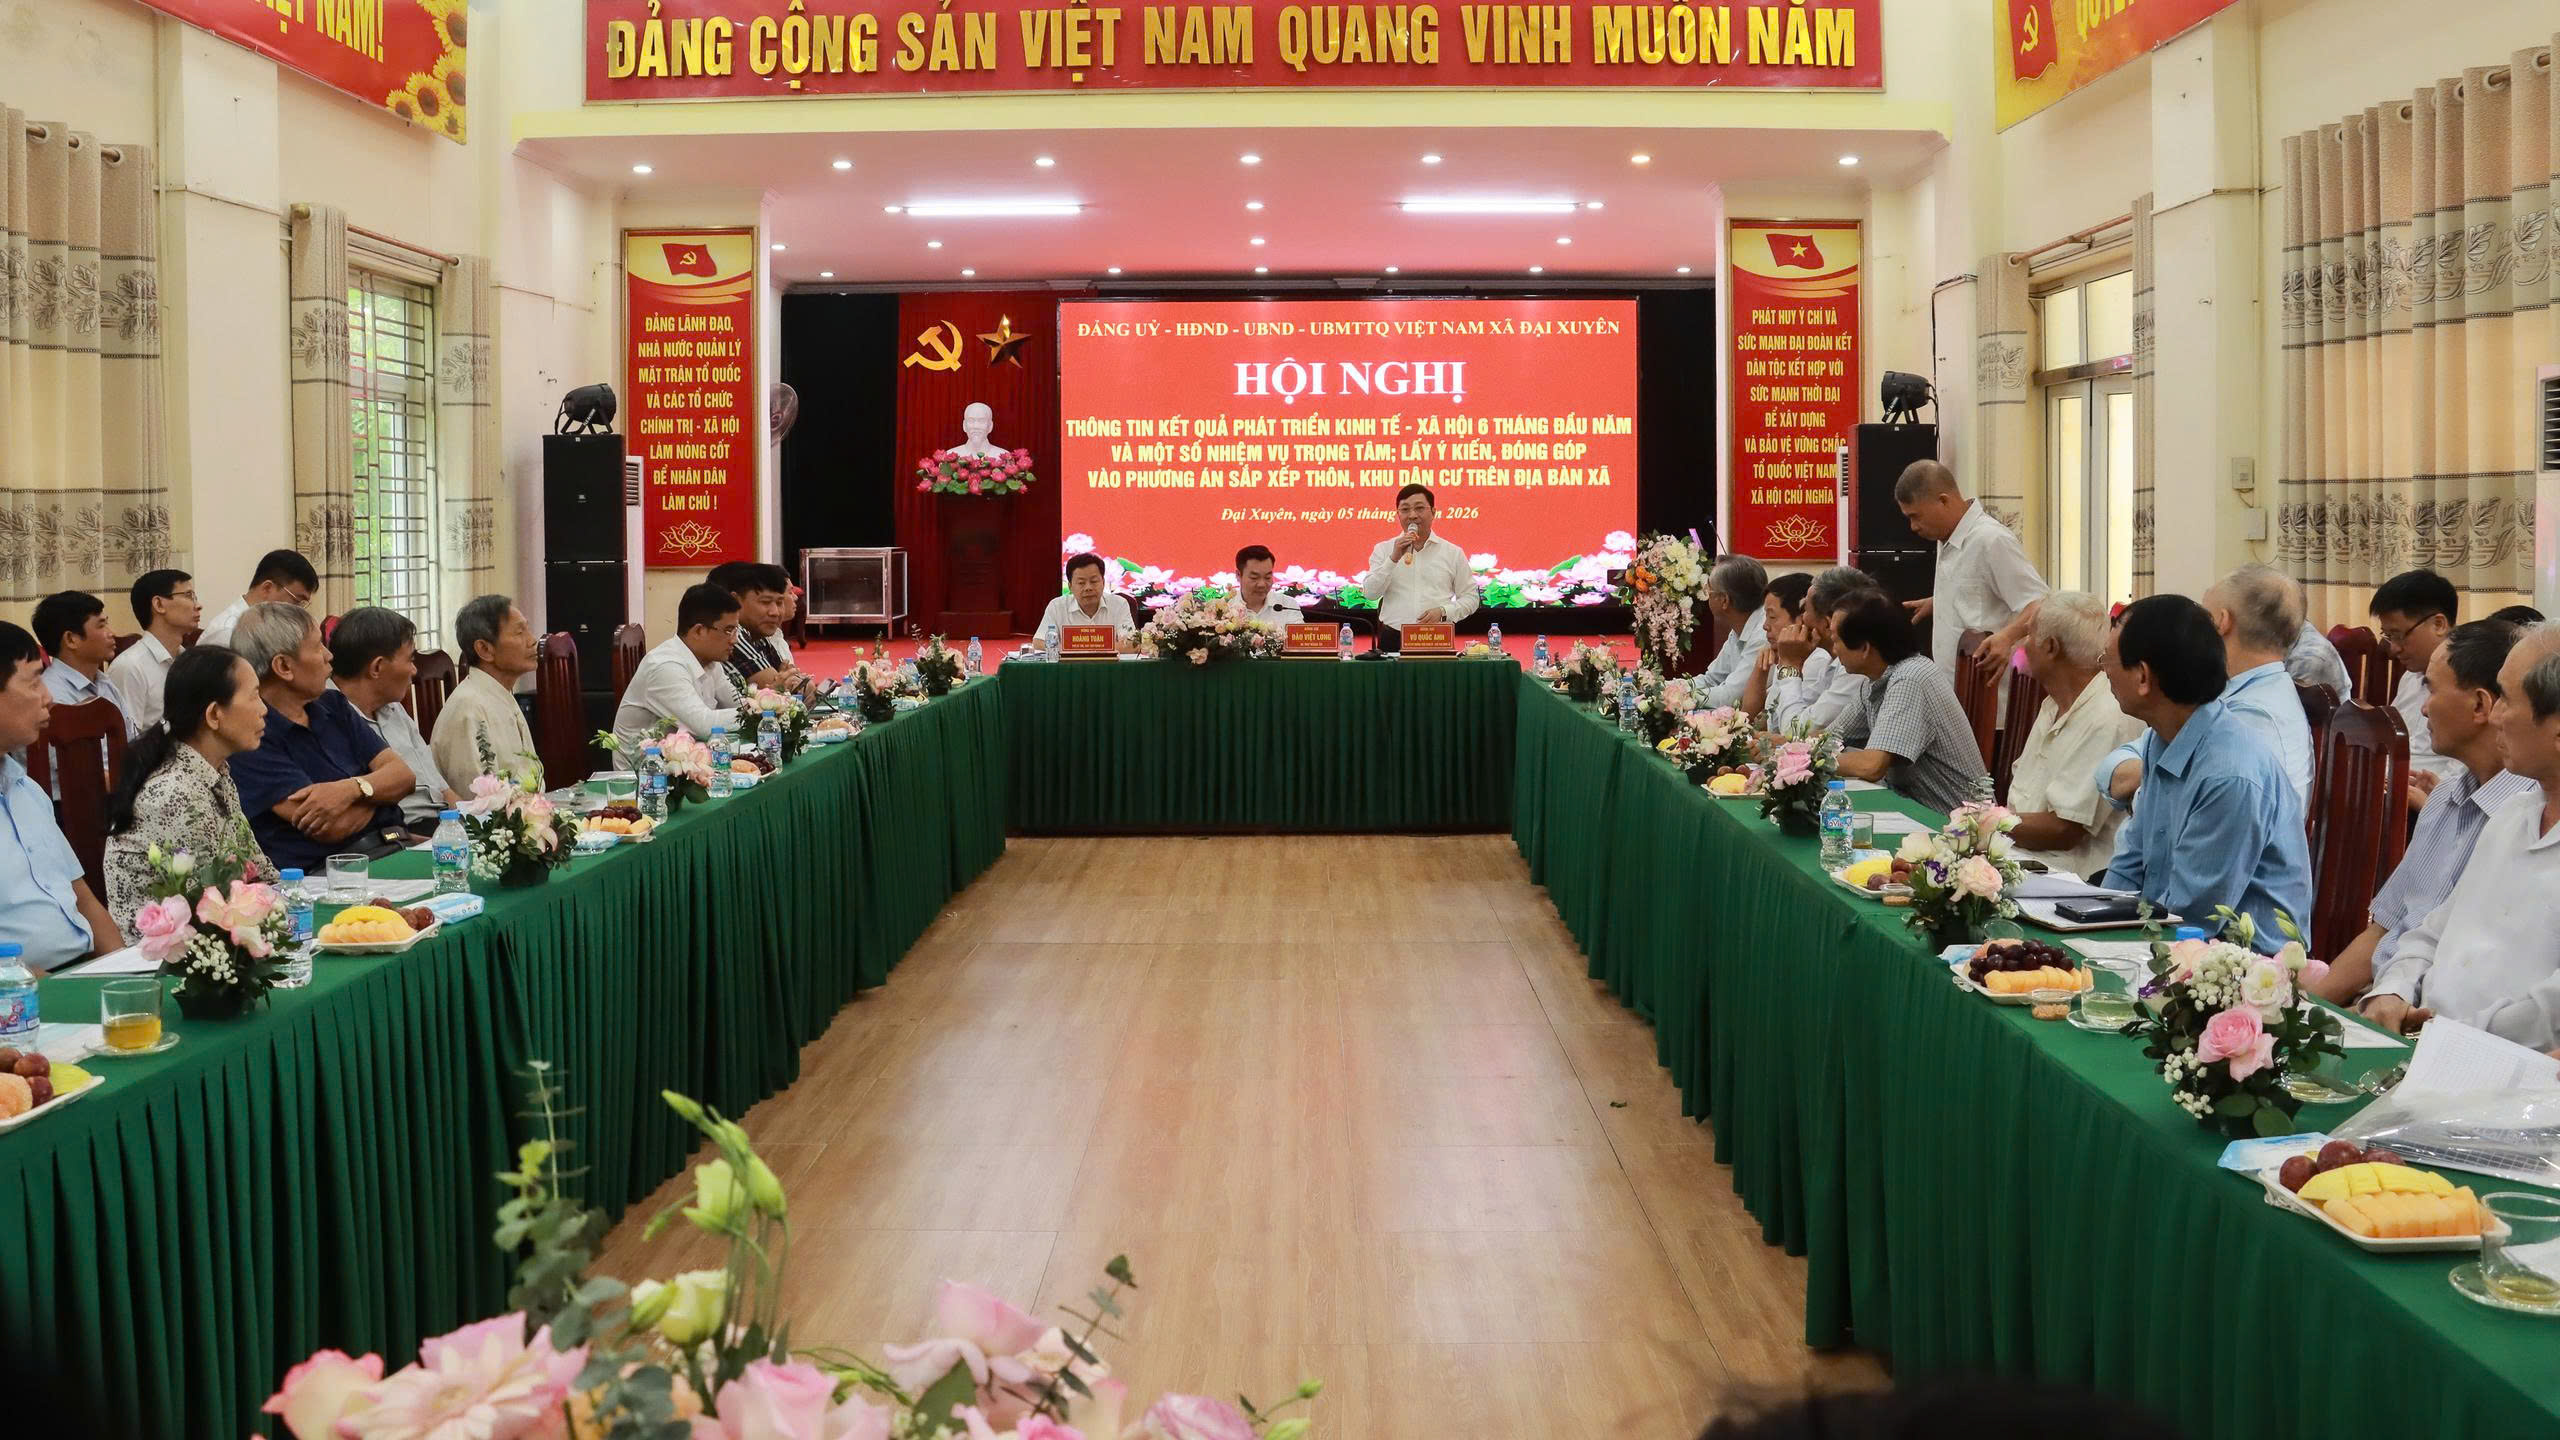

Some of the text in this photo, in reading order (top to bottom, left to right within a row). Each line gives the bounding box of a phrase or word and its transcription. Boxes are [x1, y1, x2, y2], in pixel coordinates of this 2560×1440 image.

[606, 0, 734, 78] ĐẢNG
[750, 0, 878, 89] CỘNG
[897, 0, 997, 72] SẢN
[1019, 0, 1121, 82] VIỆT
[1143, 5, 1254, 65] NAM
[1278, 5, 1439, 72] QUANG
[1461, 5, 1572, 64] VINH
[645, 312, 734, 334] ĐẢNG LÃNH ĐẠO,
[1078, 320, 1130, 336] ĐẢNG
[1176, 323, 1228, 336] HĐND
[1244, 322, 1294, 336] UBND
[1310, 321, 1390, 338] UBMTTQ
[1394, 320, 1437, 338] VIỆT
[1442, 321, 1484, 334] NAM
[1490, 318, 1514, 334] XÃ
[1520, 321, 1551, 337] ĐẠI
[1557, 317, 1619, 334] XUYÊN
[1752, 307, 1838, 325] PHÁT HUY Ý CHÍ VÀ
[638, 337, 741, 358] NHÀ NƯỚC QUẢN LÝ
[1738, 330, 1852, 354] SỨC MẠNH ĐẠI ĐOÀN KẾT
[638, 361, 741, 386] MẶT TRẬN TỔ QUỐC
[1746, 356, 1844, 380] DÂN TỘC KẾT HỢP VỚI
[1233, 357, 1467, 404] HỘI NGHỊ
[646, 387, 733, 408] VÀ CÁC TỔ CHỨC
[1750, 383, 1841, 405] SỨC MẠNH THỜI ĐẠI
[640, 415, 673, 434] CHÍNH
[676, 418, 694, 437] TRỊ
[704, 415, 719, 434] XÃ
[721, 415, 740, 437] HỘI
[1066, 416, 1121, 437] THÔNG
[1126, 419, 1153, 436] TIN
[1159, 414, 1189, 436] KẾT
[1194, 413, 1229, 438] QUẢ
[1233, 415, 1276, 436] PHÁT
[1281, 412, 1330, 436] TRIỂN
[1335, 418, 1376, 435] KINH
[1381, 413, 1401, 435] TẾ
[1417, 415, 1440, 435] XÃ
[1445, 414, 1473, 438] HỘI
[1478, 418, 1489, 435] 6
[1493, 414, 1549, 435] THÁNG
[1553, 412, 1588, 435] ĐẦU
[1592, 414, 1632, 434] NĂM
[1765, 406, 1826, 431] ĐỂ XÂY DỰNG
[649, 438, 730, 459] LÀM NÒNG CỐT
[1111, 438, 1587, 466] VÀ MỘT SỐ NHIỆM VỤ TRỌNG TÂM; LẤY Ý KIẾN, ĐÓNG GÓP
[1744, 435, 1757, 453] VÀ
[1759, 433, 1778, 453] BẢO
[1780, 435, 1792, 456] VỆ
[1794, 435, 1819, 453] VỮNG
[653, 464, 726, 485] ĐỂ NHÂN DÂN
[1088, 464, 1611, 489] VÀO PHƯƠNG ÁN SẮP XẾP THÔN, KHU DÂN CƯ TRÊN ĐỊA BÀN XÃ
[1753, 458, 1765, 479] TỔ
[1767, 458, 1792, 480] QUỐC
[1794, 460, 1814, 482] VIỆT
[662, 492, 685, 511] LÀM
[688, 490, 710, 511] CHỦ
[1751, 484, 1834, 508] XÃ HỘI CHỦ NGHĨA
[1221, 508, 1246, 522] Đại
[1249, 507, 1297, 522] Xuyên,
[1301, 508, 1334, 523] ngày
[1337, 508, 1354, 520] 05
[1446, 507, 1479, 519] 2026
